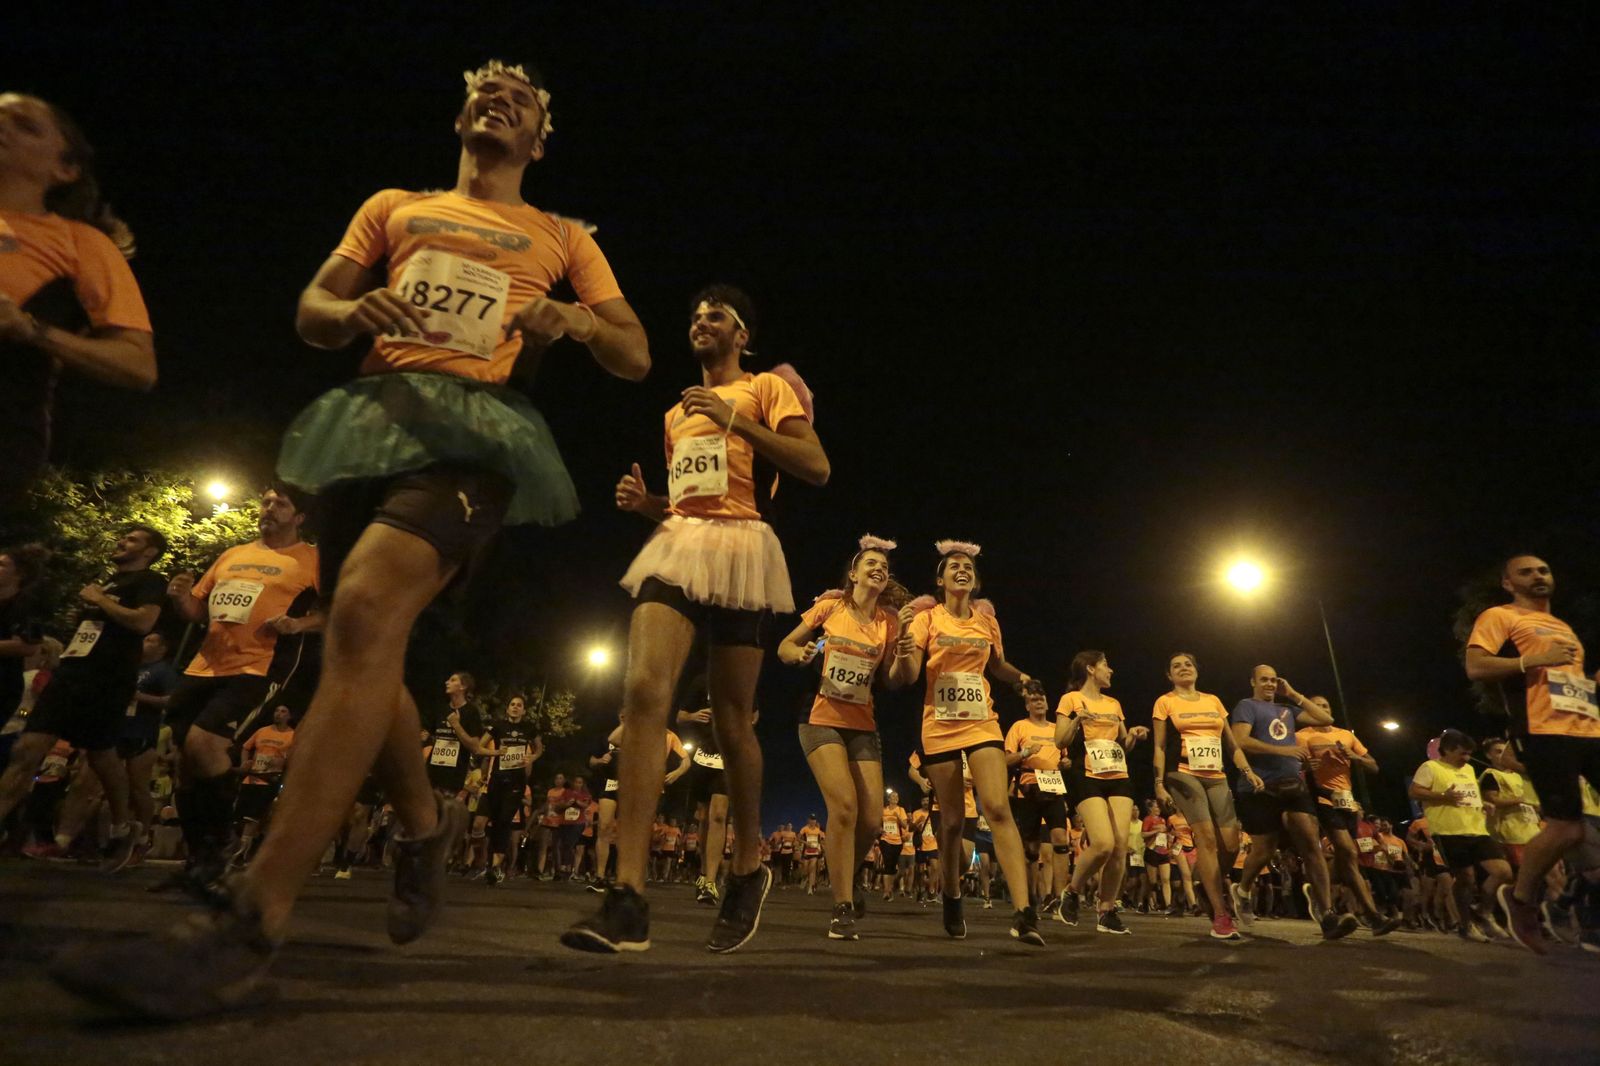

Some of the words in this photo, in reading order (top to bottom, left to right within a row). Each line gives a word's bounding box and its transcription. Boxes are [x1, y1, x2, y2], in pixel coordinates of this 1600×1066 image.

[211, 593, 253, 607] 13569
[829, 666, 870, 688] 18294
[938, 687, 983, 702] 18286
[502, 753, 524, 762] 20801
[1190, 746, 1220, 758] 12761
[1038, 777, 1062, 785] 16808
